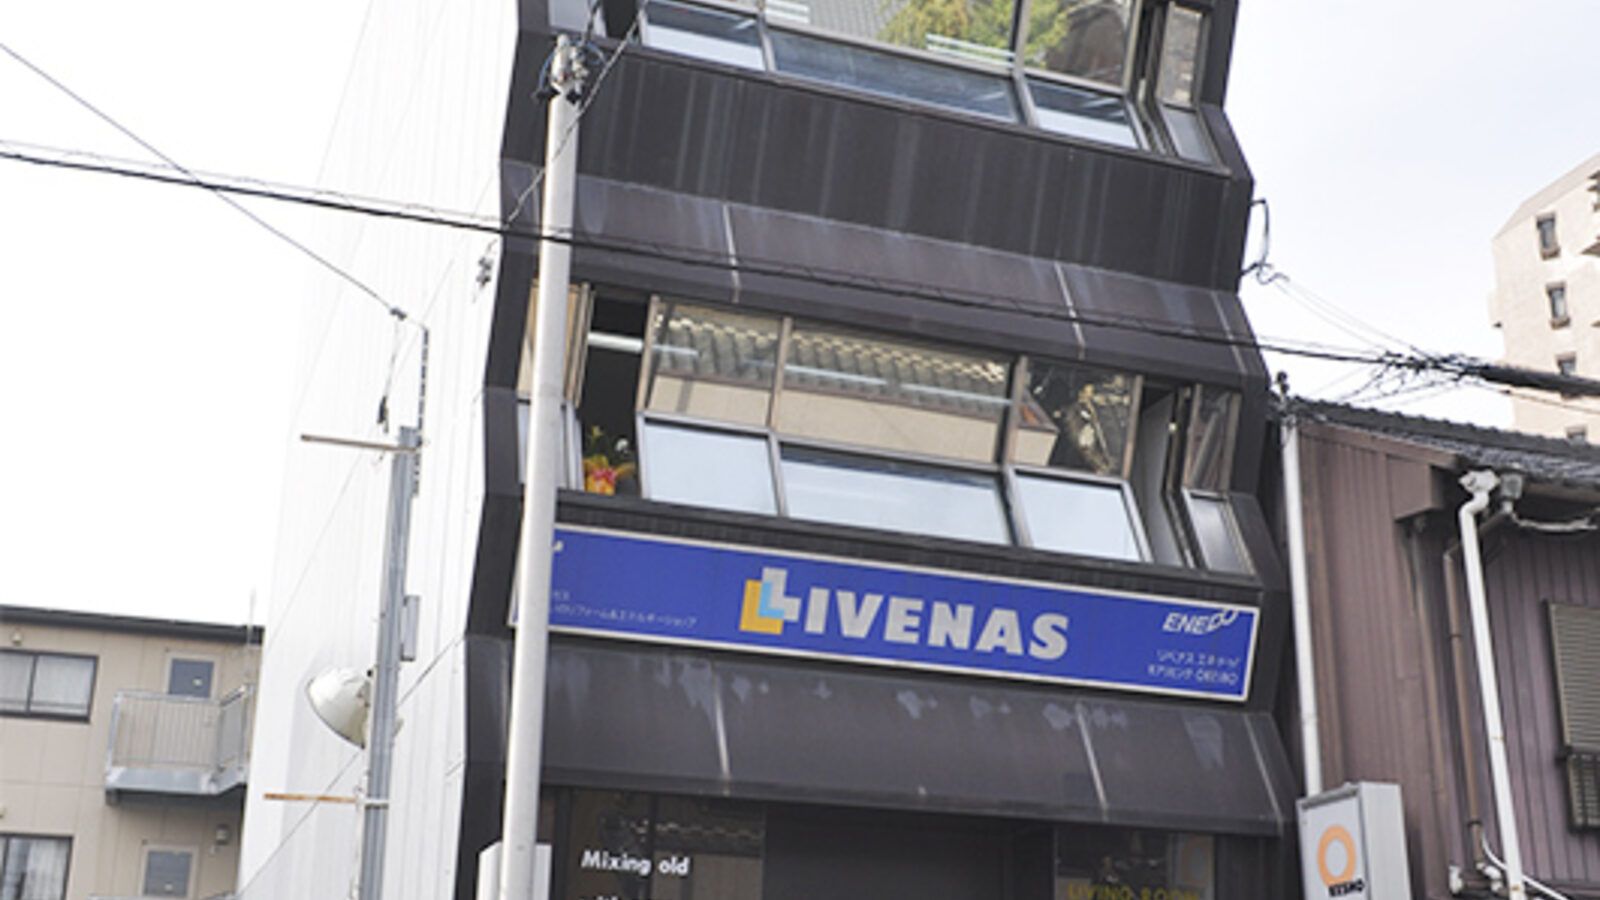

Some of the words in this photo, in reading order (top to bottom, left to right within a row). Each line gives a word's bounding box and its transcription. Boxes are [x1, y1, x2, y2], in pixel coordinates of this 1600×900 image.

[739, 567, 1069, 661] LIVENAS
[581, 850, 652, 876] Mixing
[659, 856, 691, 875] old
